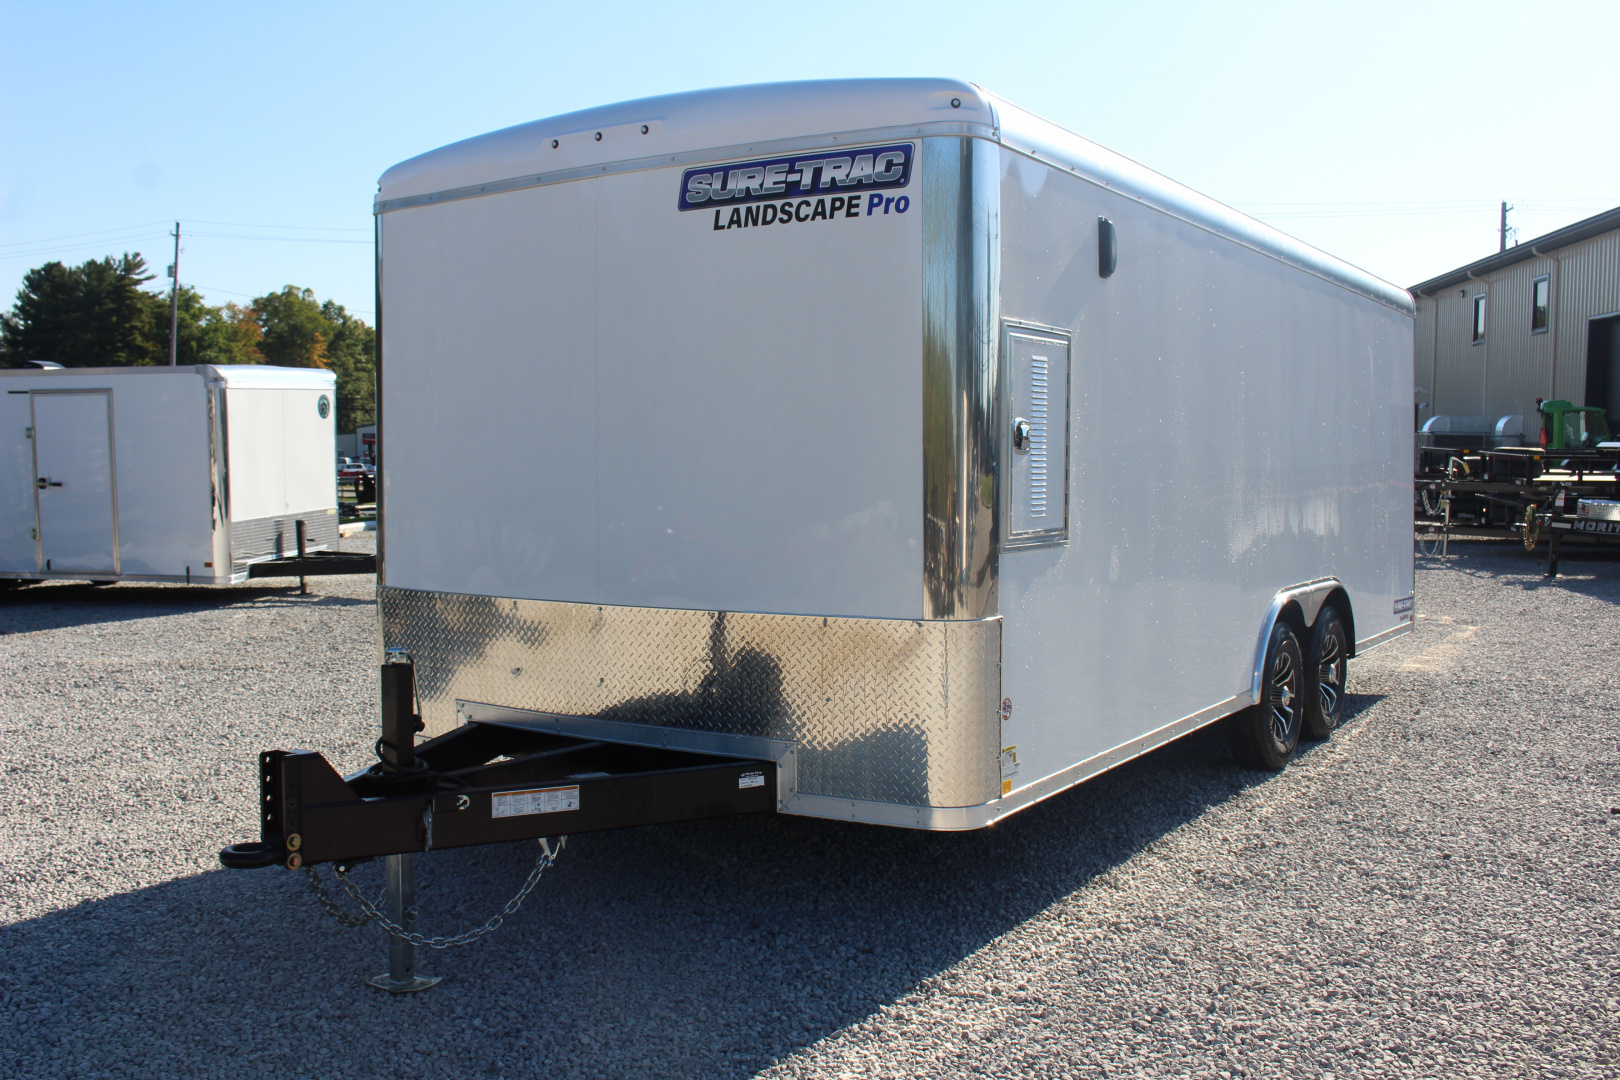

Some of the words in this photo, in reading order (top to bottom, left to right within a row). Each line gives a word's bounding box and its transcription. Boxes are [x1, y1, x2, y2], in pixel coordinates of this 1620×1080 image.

[686, 151, 906, 203] SURE-TRAC
[713, 194, 862, 231] LANDSCAPE
[866, 193, 911, 216] Pro
